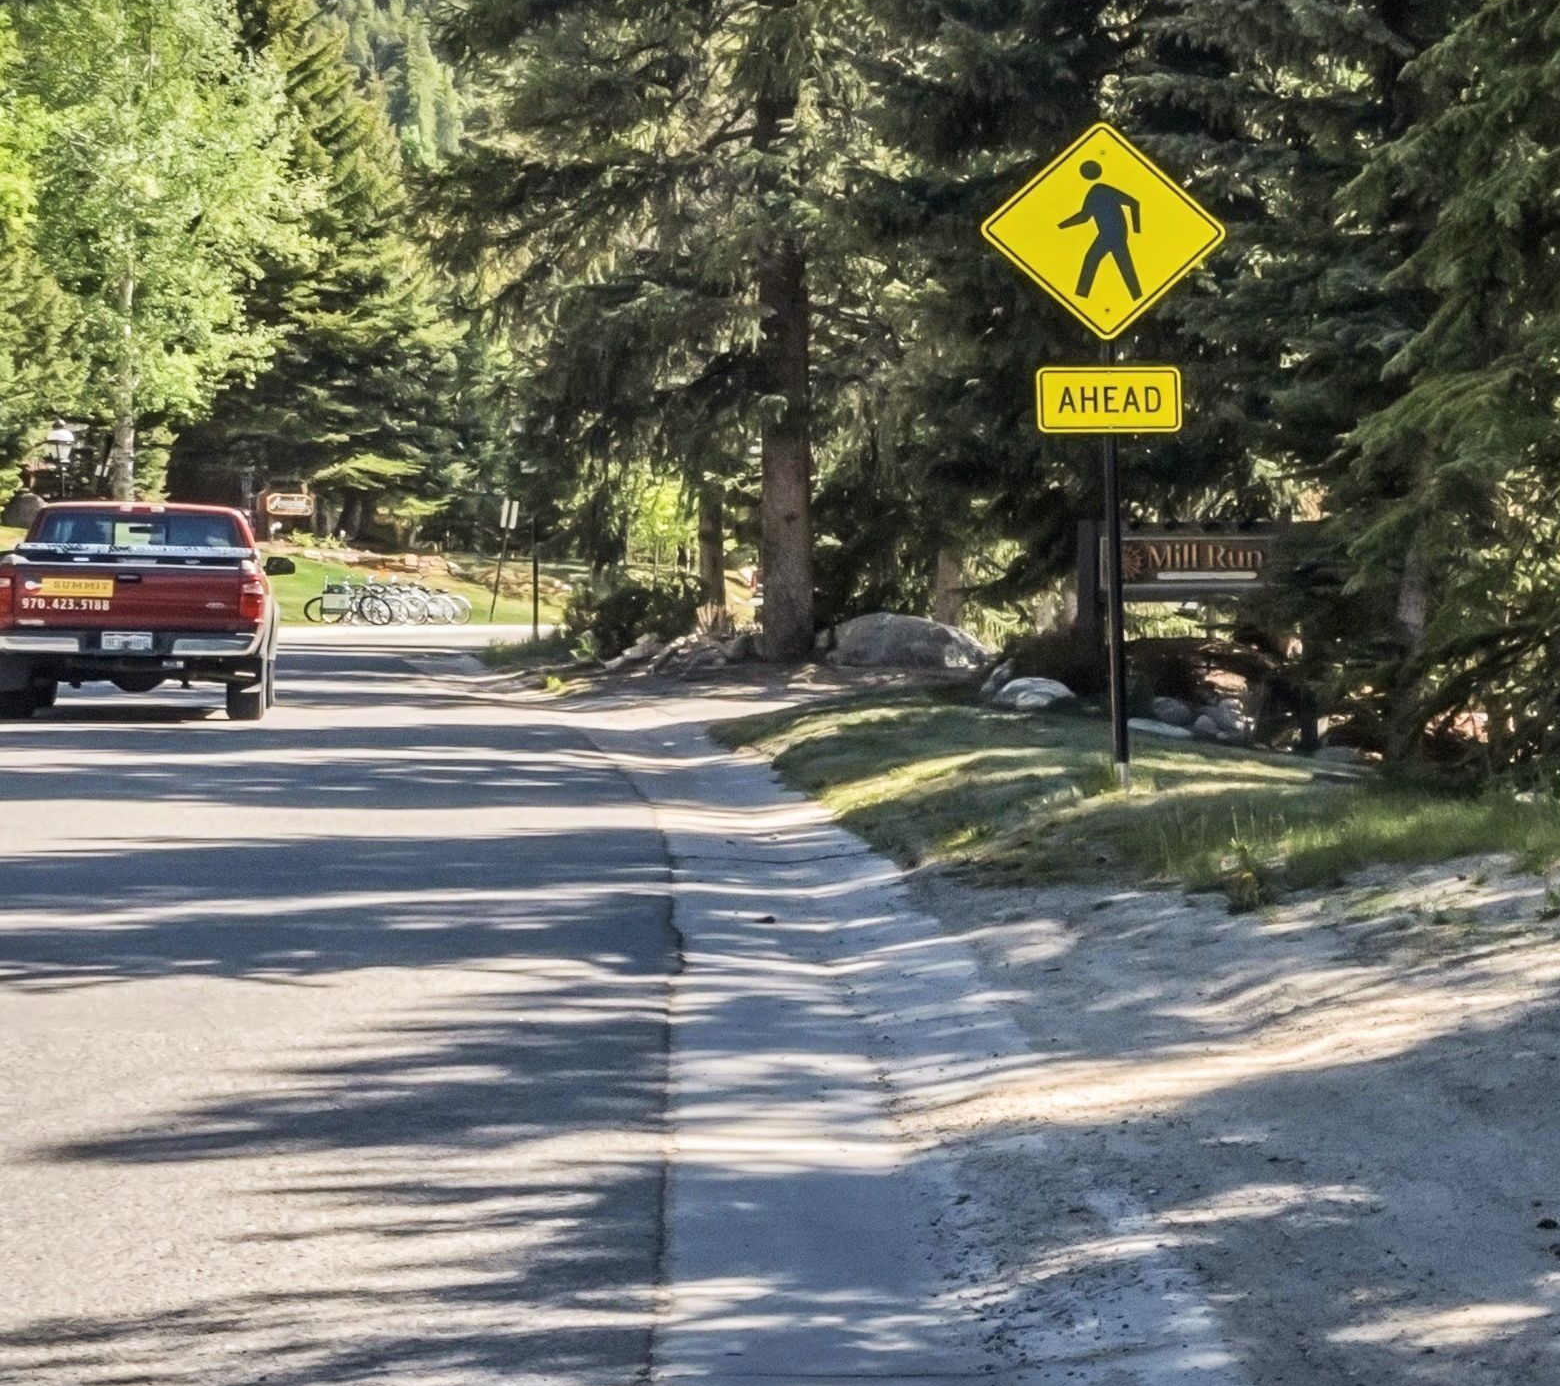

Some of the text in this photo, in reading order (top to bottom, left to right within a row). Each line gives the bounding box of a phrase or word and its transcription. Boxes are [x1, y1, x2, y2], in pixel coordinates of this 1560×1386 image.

[1058, 385, 1163, 414] AHEAD
[1147, 542, 1264, 569] Mill Run
[54, 580, 110, 591] SUMMIT
